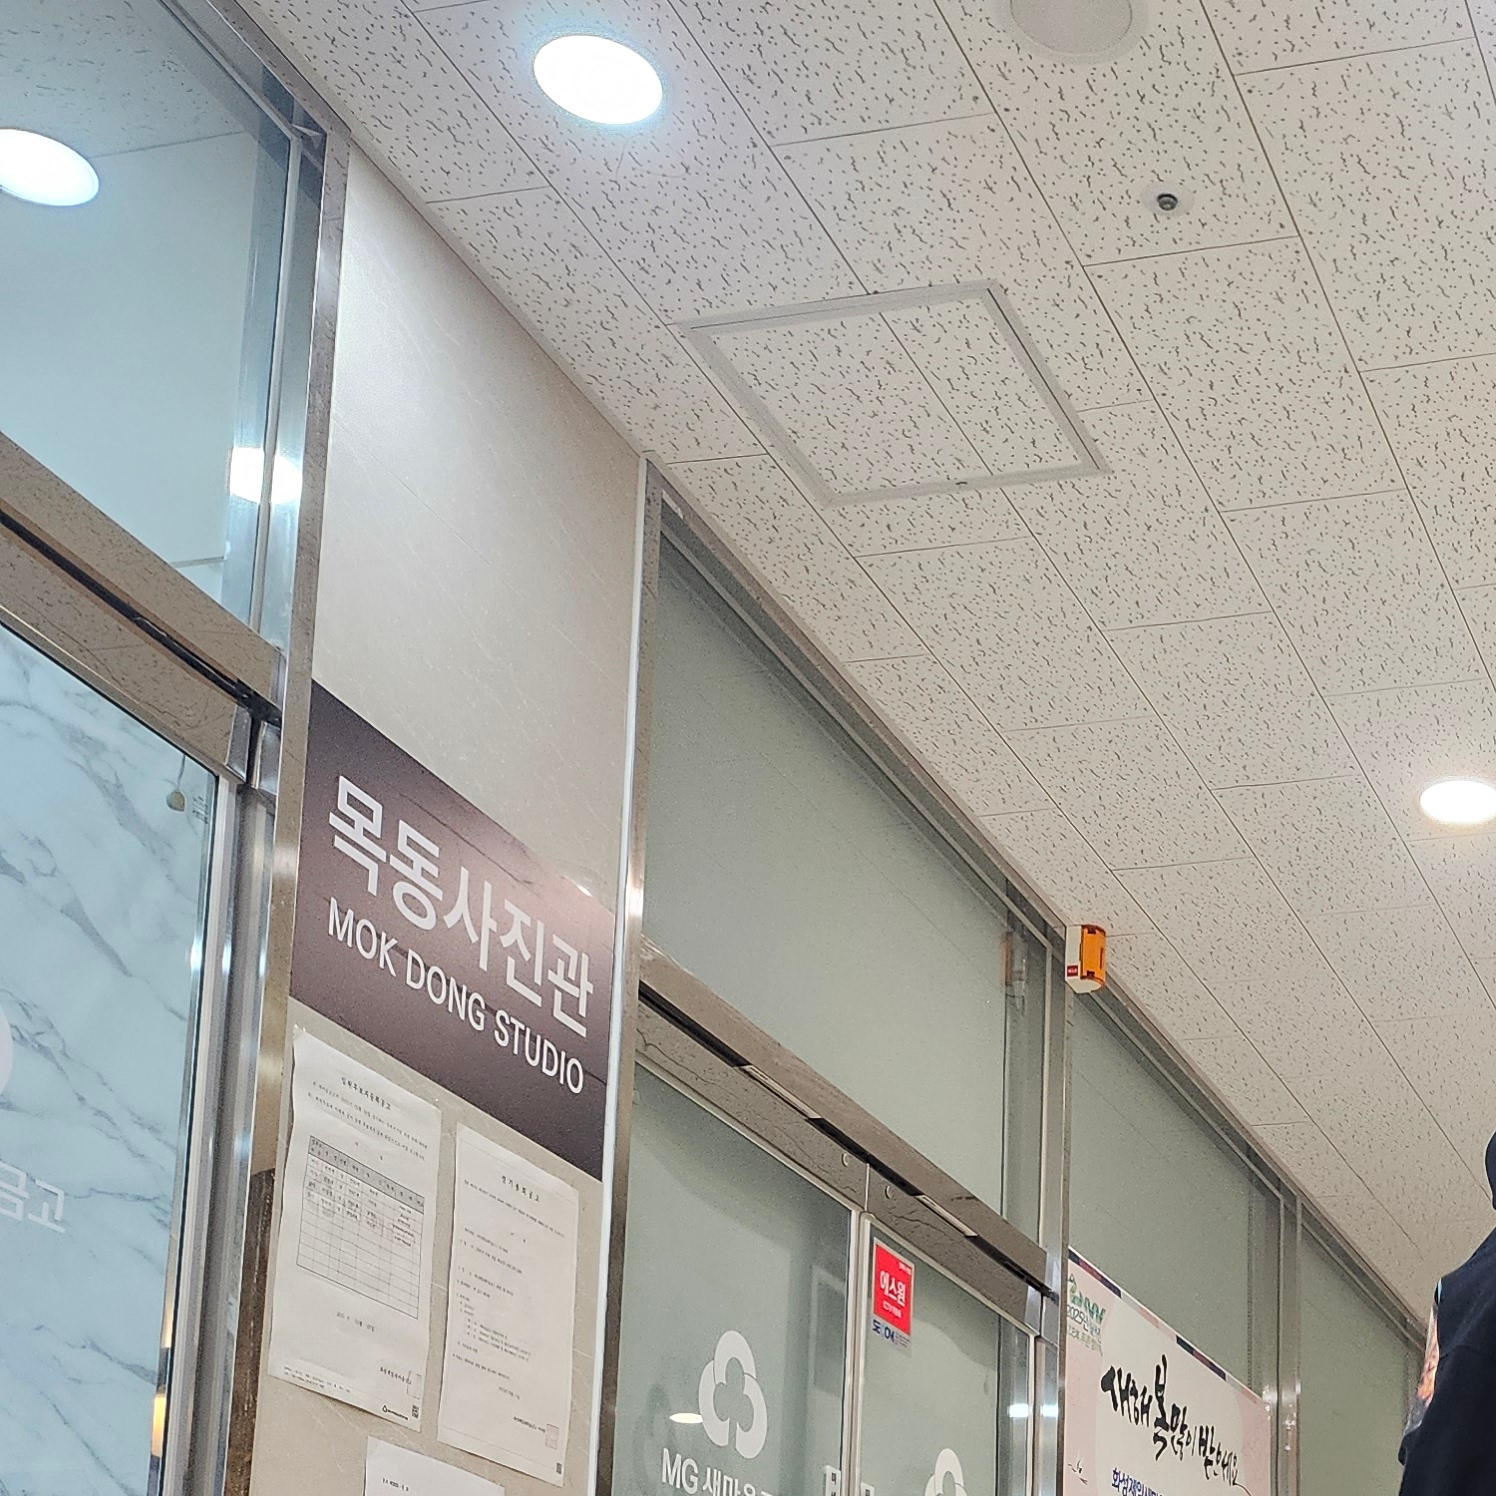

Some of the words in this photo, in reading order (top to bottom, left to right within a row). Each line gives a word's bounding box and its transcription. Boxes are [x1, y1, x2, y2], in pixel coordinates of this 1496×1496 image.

[327, 896, 397, 976] MOK
[405, 949, 486, 1032] DONG
[494, 1009, 585, 1094] STUDIO
[328, 775, 594, 1038] 목동사진관
[662, 1447, 699, 1495] MG
